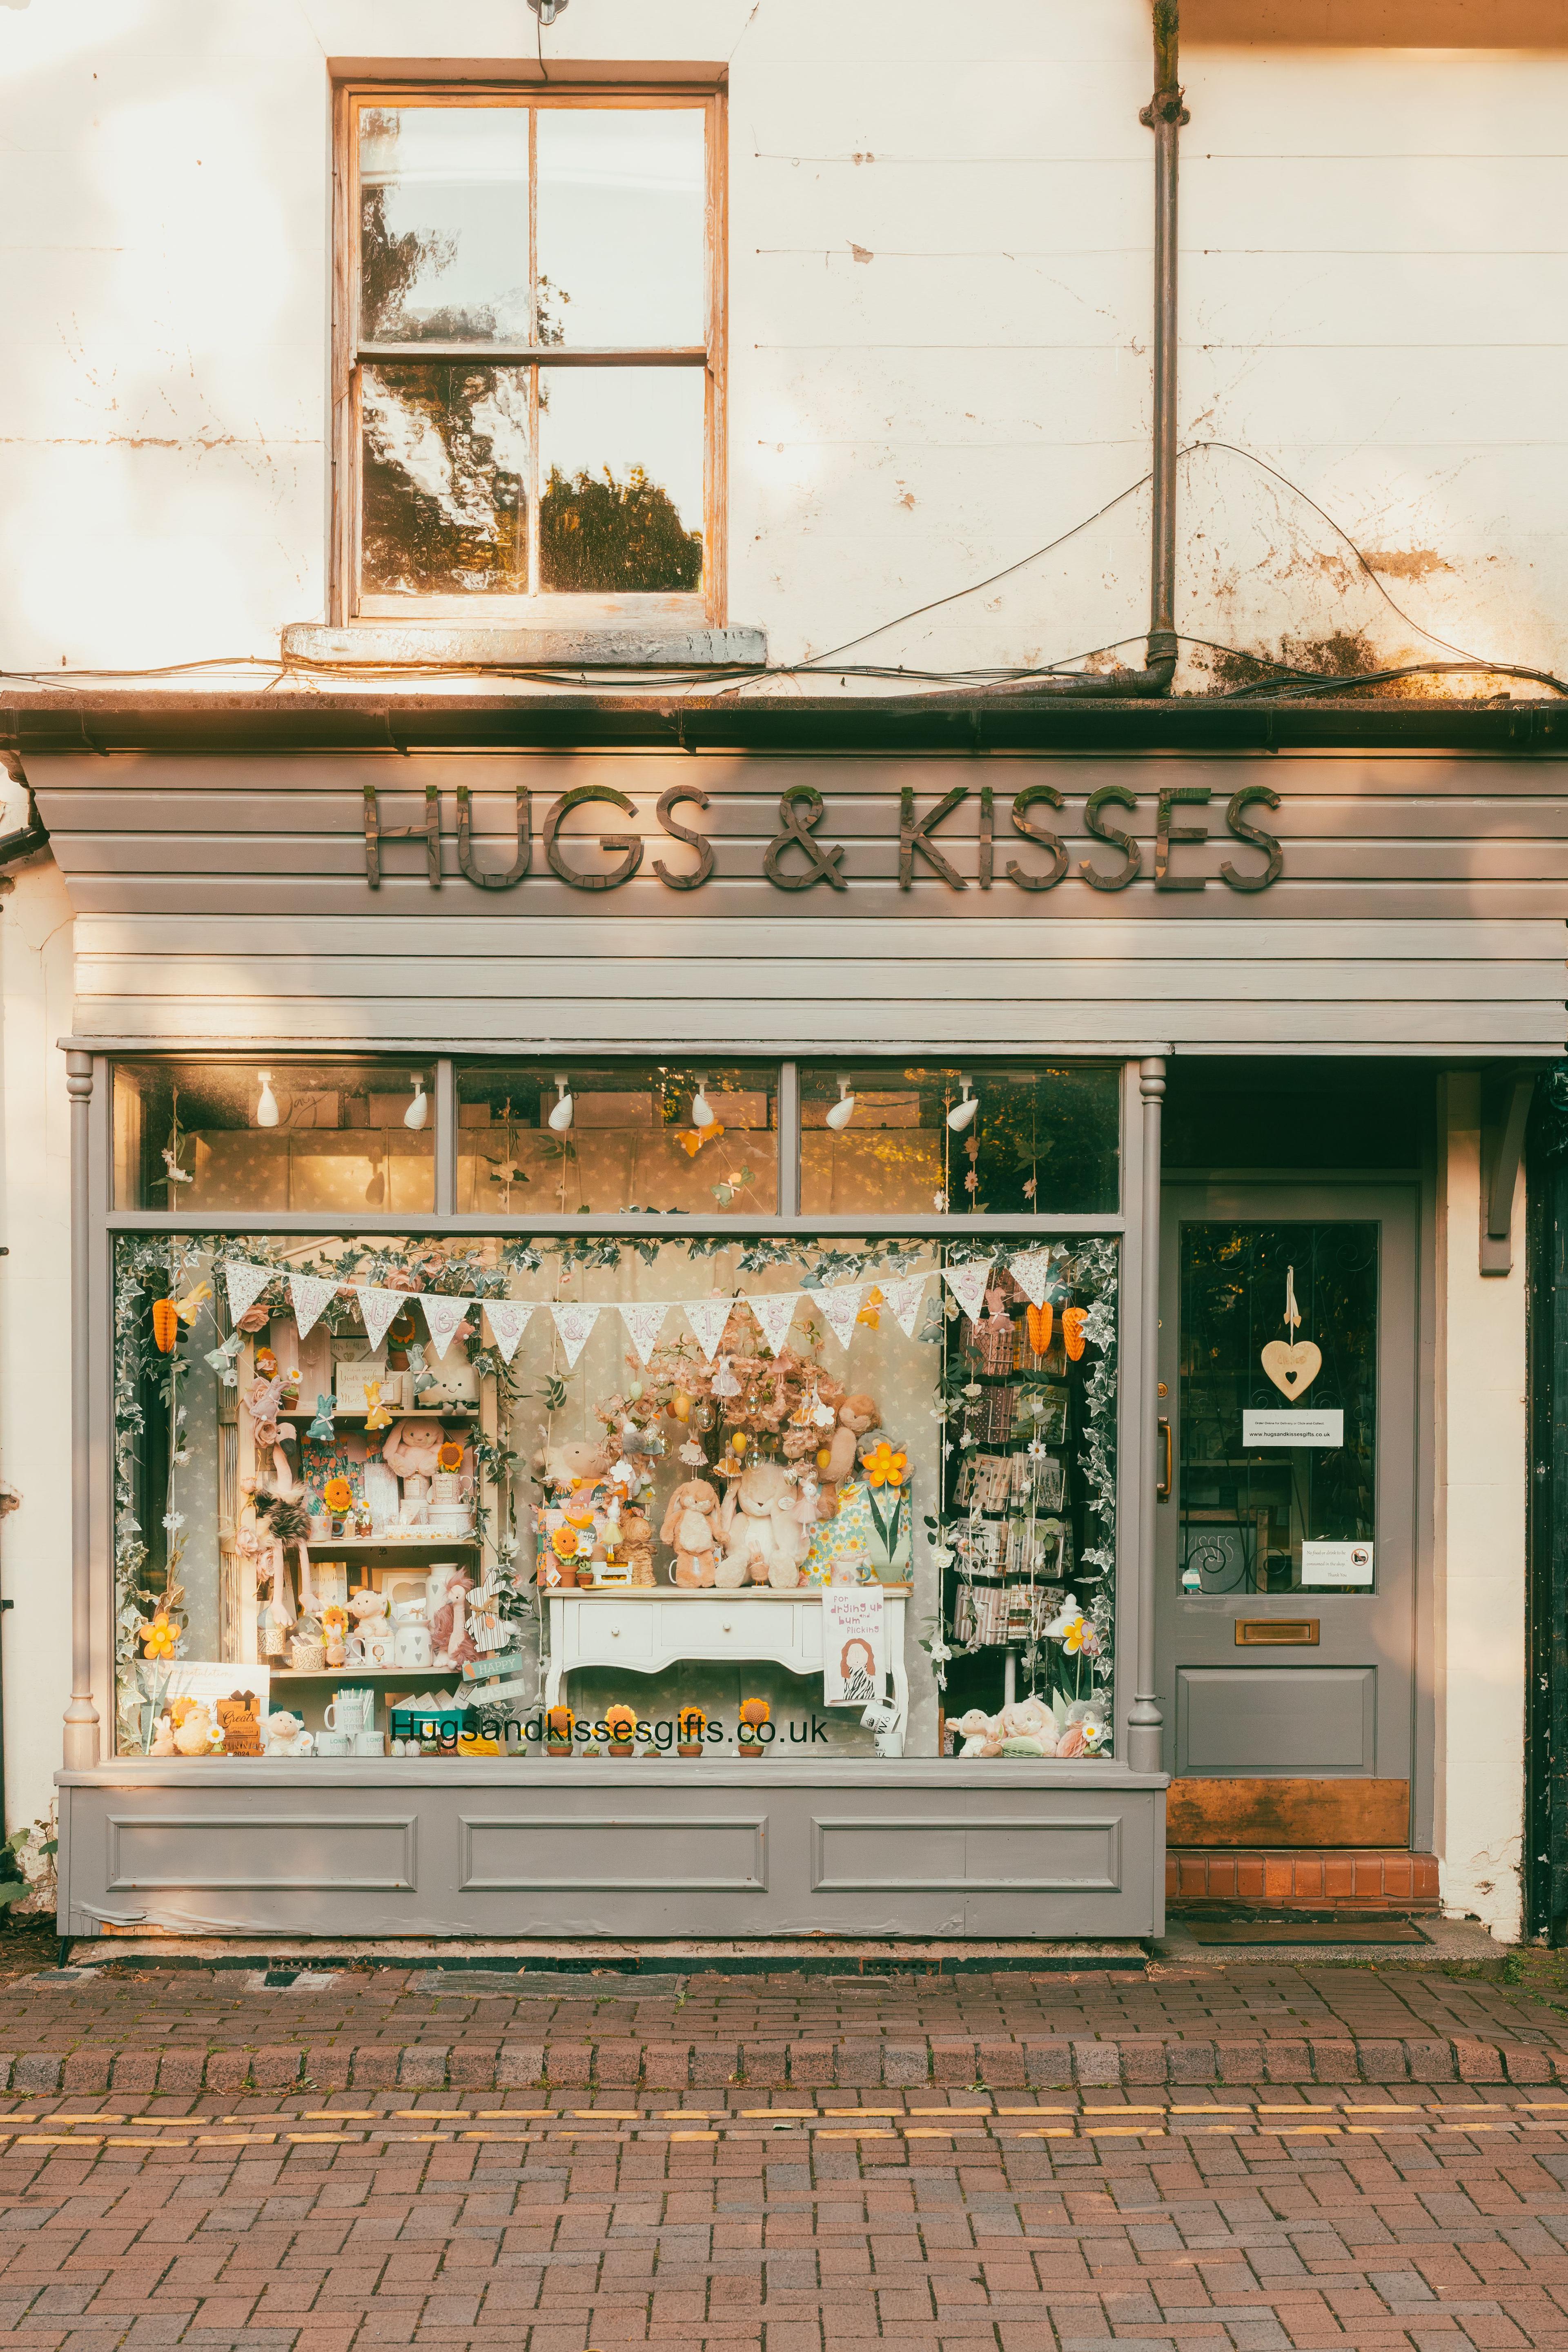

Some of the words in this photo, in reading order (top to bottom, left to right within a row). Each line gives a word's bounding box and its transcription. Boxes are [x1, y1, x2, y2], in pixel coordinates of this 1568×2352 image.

[364, 785, 714, 891] HUGS
[767, 785, 849, 889] &
[899, 785, 1283, 891] KISSES
[831, 1603, 866, 1613] drying
[870, 1603, 882, 1612] up
[839, 1616, 860, 1625] bum
[478, 1659, 516, 1675] HAPPY
[479, 1681, 524, 1701] EASTER
[222, 1711, 255, 1728] Greats
[391, 1712, 828, 1751] Hugsandkissesgifts.co.uk
